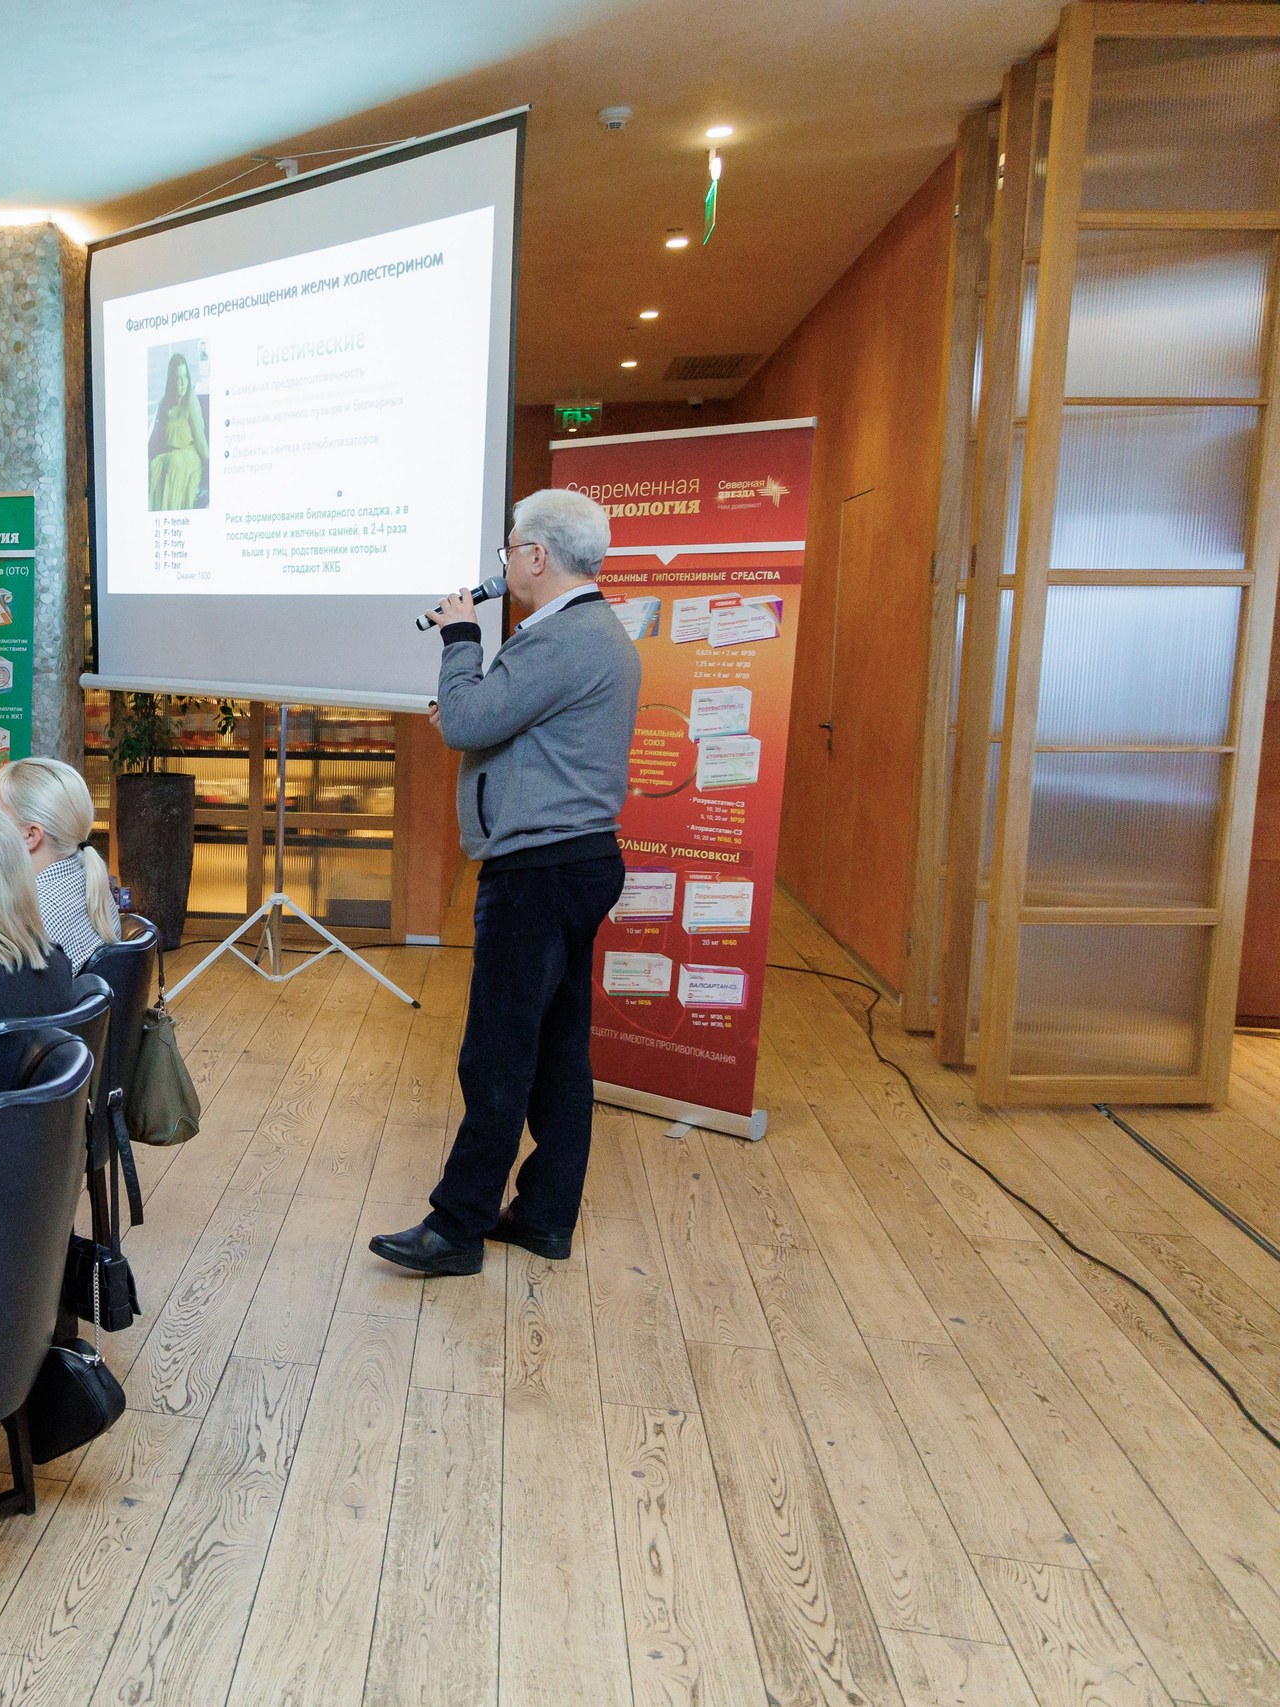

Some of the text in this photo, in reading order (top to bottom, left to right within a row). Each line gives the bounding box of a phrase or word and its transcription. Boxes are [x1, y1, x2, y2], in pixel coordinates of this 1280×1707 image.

[126, 252, 444, 333] Факторы риска перенасыщения желчи холестерином
[256, 331, 366, 367] Генетические
[271, 368, 366, 393] предрасположенность
[353, 396, 404, 413] билиарных
[566, 478, 700, 503] Современная
[718, 480, 765, 490] Северная
[718, 489, 755, 499] ЗВЕЗДА
[225, 512, 243, 524] Риск
[245, 511, 304, 525] формирования
[306, 507, 355, 521] билиарного
[358, 506, 392, 518] сладжа,
[403, 505, 409, 514] в
[171, 517, 190, 526] female
[226, 530, 281, 542] последующем
[289, 528, 326, 538] желчных
[328, 525, 360, 537] камней,
[363, 526, 368, 535] в
[370, 523, 384, 534] 2-4
[387, 524, 407, 537] раза
[242, 544, 387, 559] выше у лиц, родственники которых
[5, 566, 29, 577] (OTC)
[283, 560, 340, 576] страдают ЖКБ
[198, 571, 211, 580] 1930
[651, 572, 726, 582] ГИПОТЕНЗИВНЫЕ
[730, 570, 781, 581] СРЕДСТВА
[643, 738, 665, 747] СОЮЗ
[630, 748, 643, 756] для
[639, 768, 664, 776] уровня
[630, 777, 673, 786] холестерина
[692, 796, 745, 808] Розувастатин-СЗ
[690, 824, 743, 836] Аторвастатин-СЗ
[616, 838, 740, 864] ОЛЬШИХ упаковках!
[622, 883, 673, 892] ерканидипин-СЗ
[644, 927, 660, 935] №60
[688, 982, 737, 990] ВАЛСАРТАН-СЗ
[619, 1032, 655, 1047] ИМЕЮТСЯ
[656, 1039, 738, 1065] ПРОТИВОПОКАЗАНИЯ.
